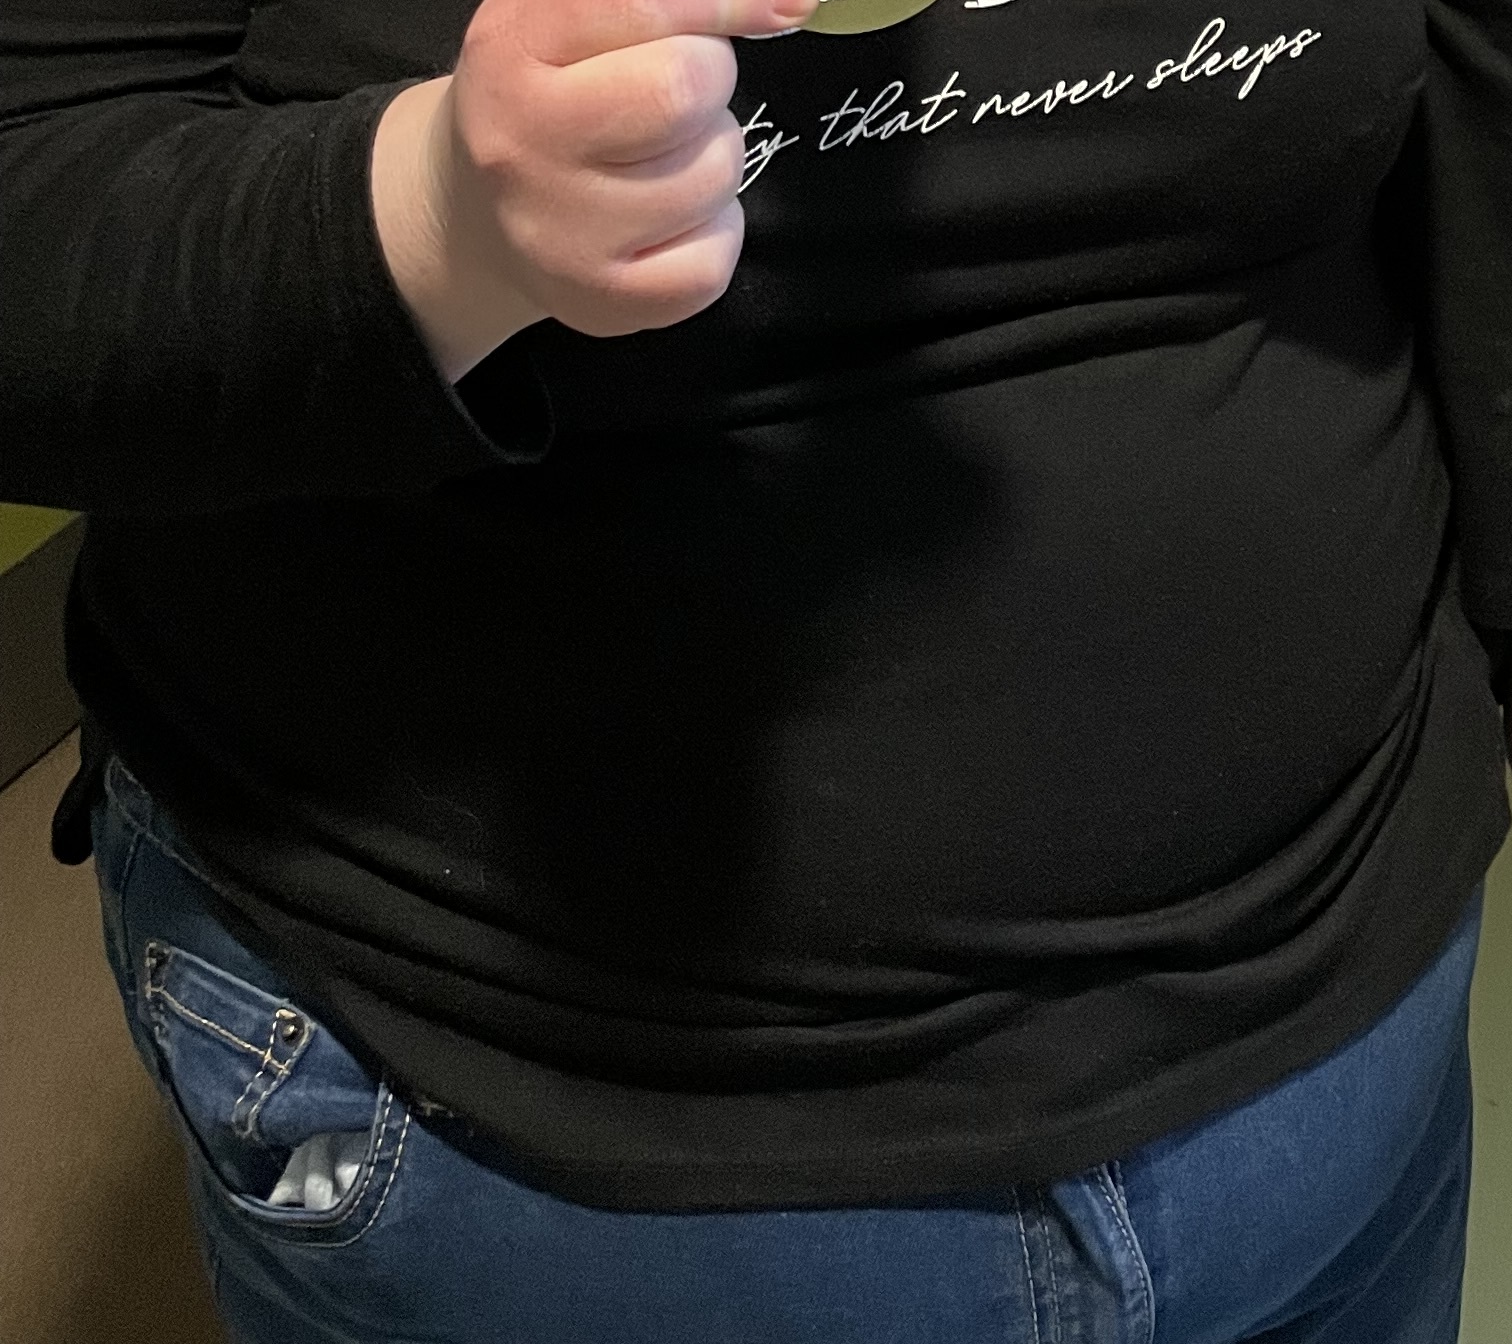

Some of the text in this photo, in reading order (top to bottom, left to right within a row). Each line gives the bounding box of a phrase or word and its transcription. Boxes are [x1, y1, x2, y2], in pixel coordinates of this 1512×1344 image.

[818, 80, 967, 152] that
[972, 73, 1136, 124] never
[1145, 17, 1322, 100] sleeps
